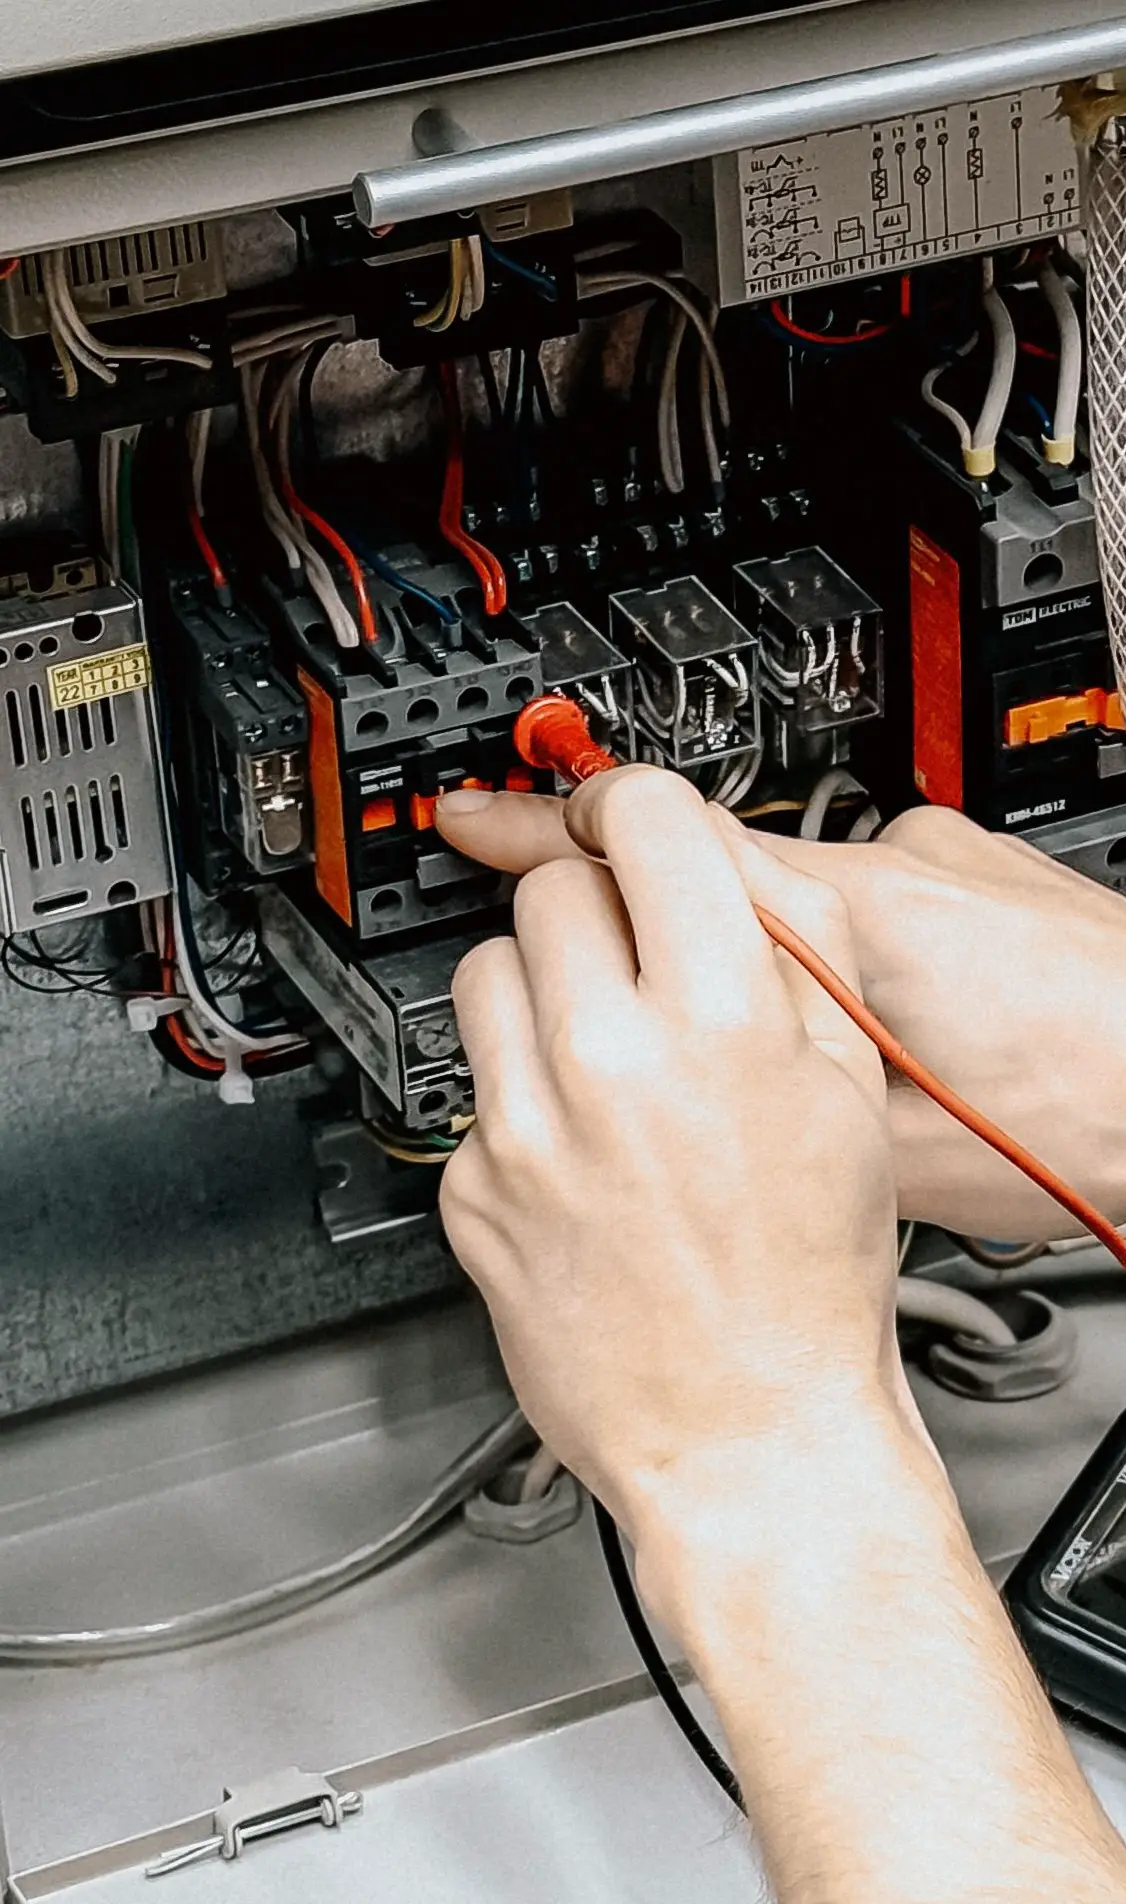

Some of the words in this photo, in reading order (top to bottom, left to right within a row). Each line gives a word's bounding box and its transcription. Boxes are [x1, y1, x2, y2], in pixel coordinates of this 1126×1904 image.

[1038, 595, 1092, 619] ELECTRIC
[56, 667, 79, 684] YEAR
[111, 665, 119, 676] 2
[132, 659, 140, 670] 3
[59, 684, 81, 703] 22
[90, 684, 98, 696] 7
[111, 679, 119, 691] 8
[133, 673, 142, 684] 9
